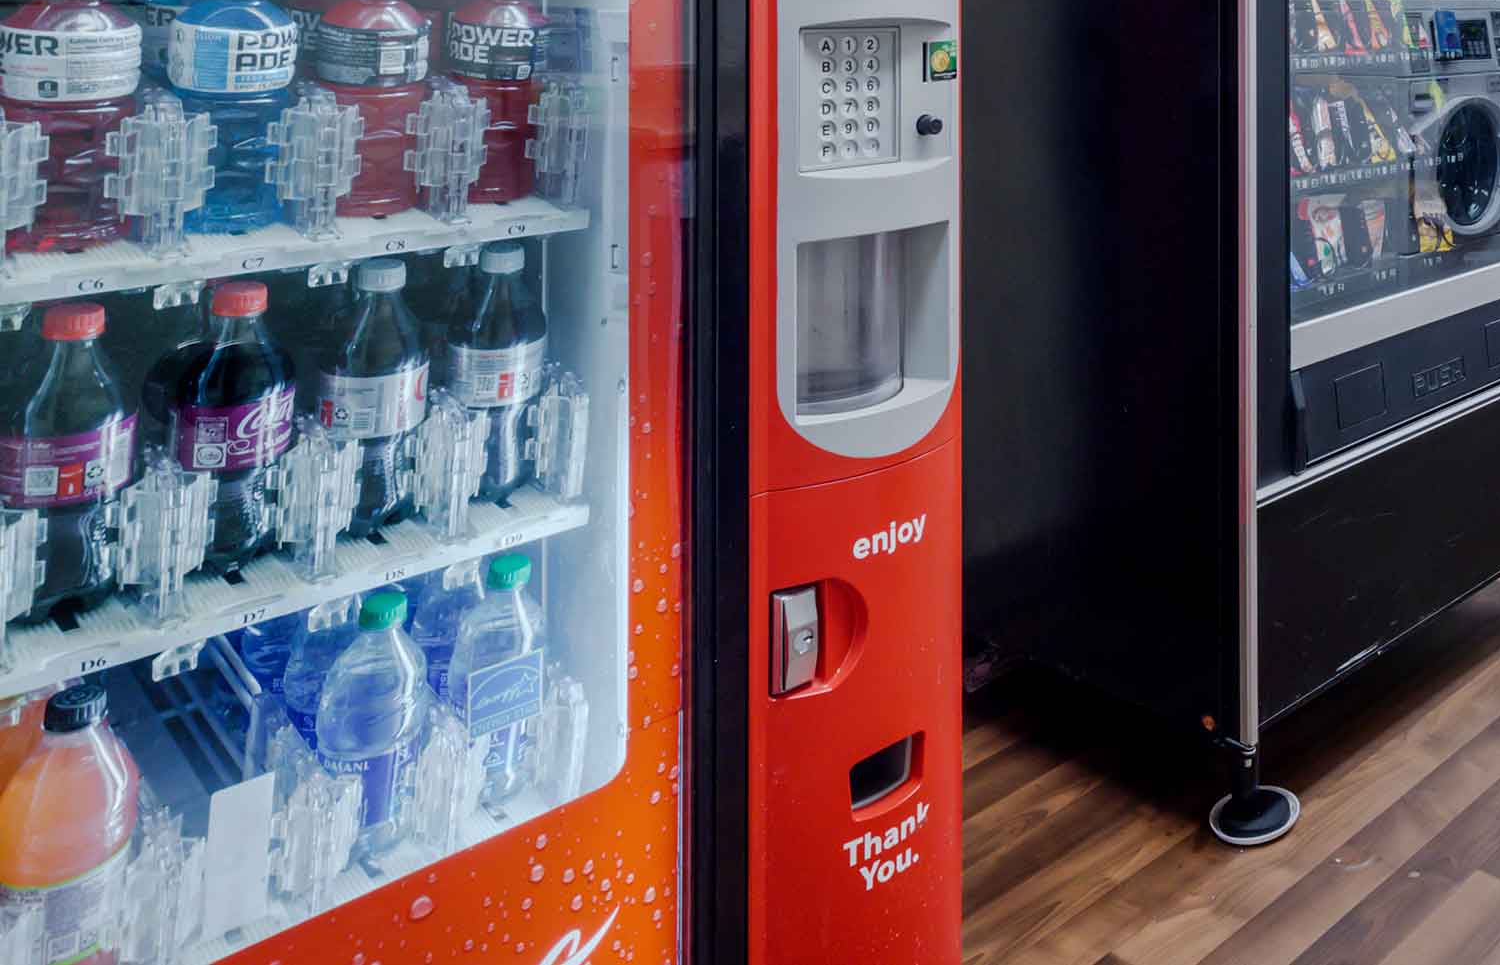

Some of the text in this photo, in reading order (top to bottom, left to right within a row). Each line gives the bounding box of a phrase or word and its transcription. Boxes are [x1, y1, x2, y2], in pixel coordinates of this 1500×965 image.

[451, 26, 536, 48] POWER
[822, 39, 874, 51] A 1 2
[451, 44, 490, 64] ADE
[236, 52, 289, 73] ADE
[822, 60, 874, 73] B 3 4
[822, 80, 874, 94] C 5 6
[822, 101, 874, 115] D 7 8
[822, 121, 874, 136] E 9 0
[822, 146, 830, 157] F
[508, 224, 526, 236] C9
[385, 239, 406, 251] C8
[242, 256, 265, 270] C7
[78, 278, 104, 293] C6
[504, 533, 523, 546] D9
[852, 513, 927, 560] enjoy
[384, 569, 406, 581] D8
[242, 609, 266, 624] D7
[80, 657, 107, 673] D6
[843, 802, 930, 868] Thank
[858, 852, 919, 891] You.
